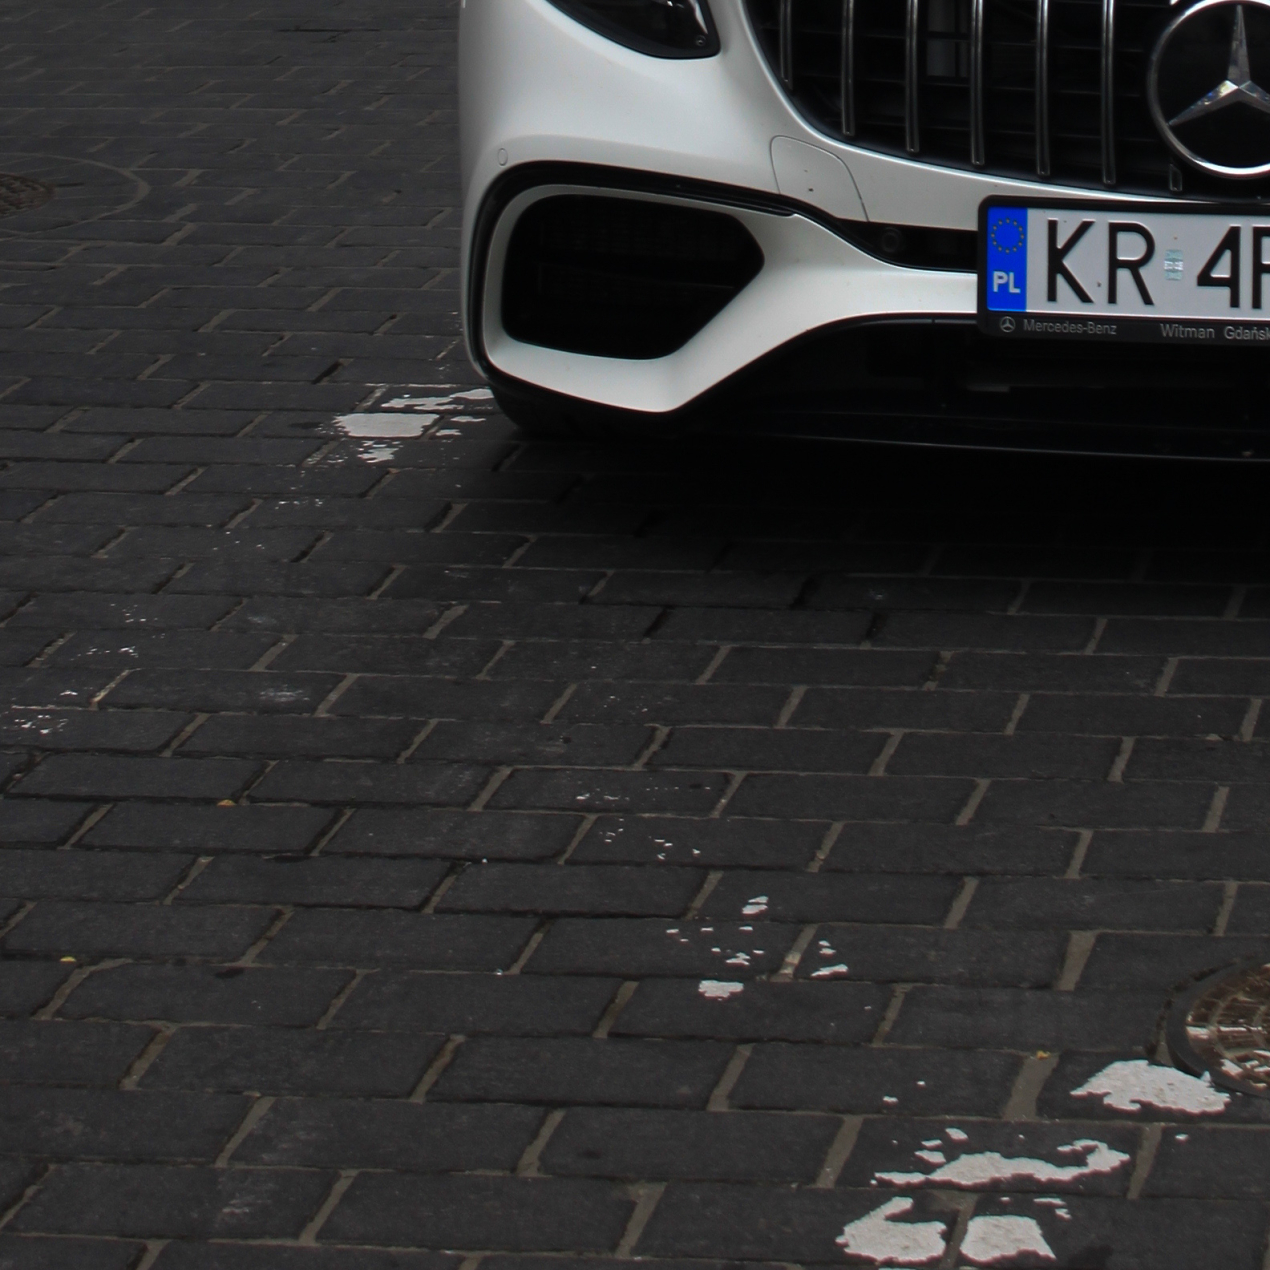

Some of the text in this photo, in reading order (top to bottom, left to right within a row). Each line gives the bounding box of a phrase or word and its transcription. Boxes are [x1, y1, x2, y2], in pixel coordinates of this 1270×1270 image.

[1047, 217, 1156, 306] KR
[993, 270, 1021, 295] PL
[1023, 319, 1117, 337] Mercedes-Benz
[1160, 322, 1215, 340] Witman
